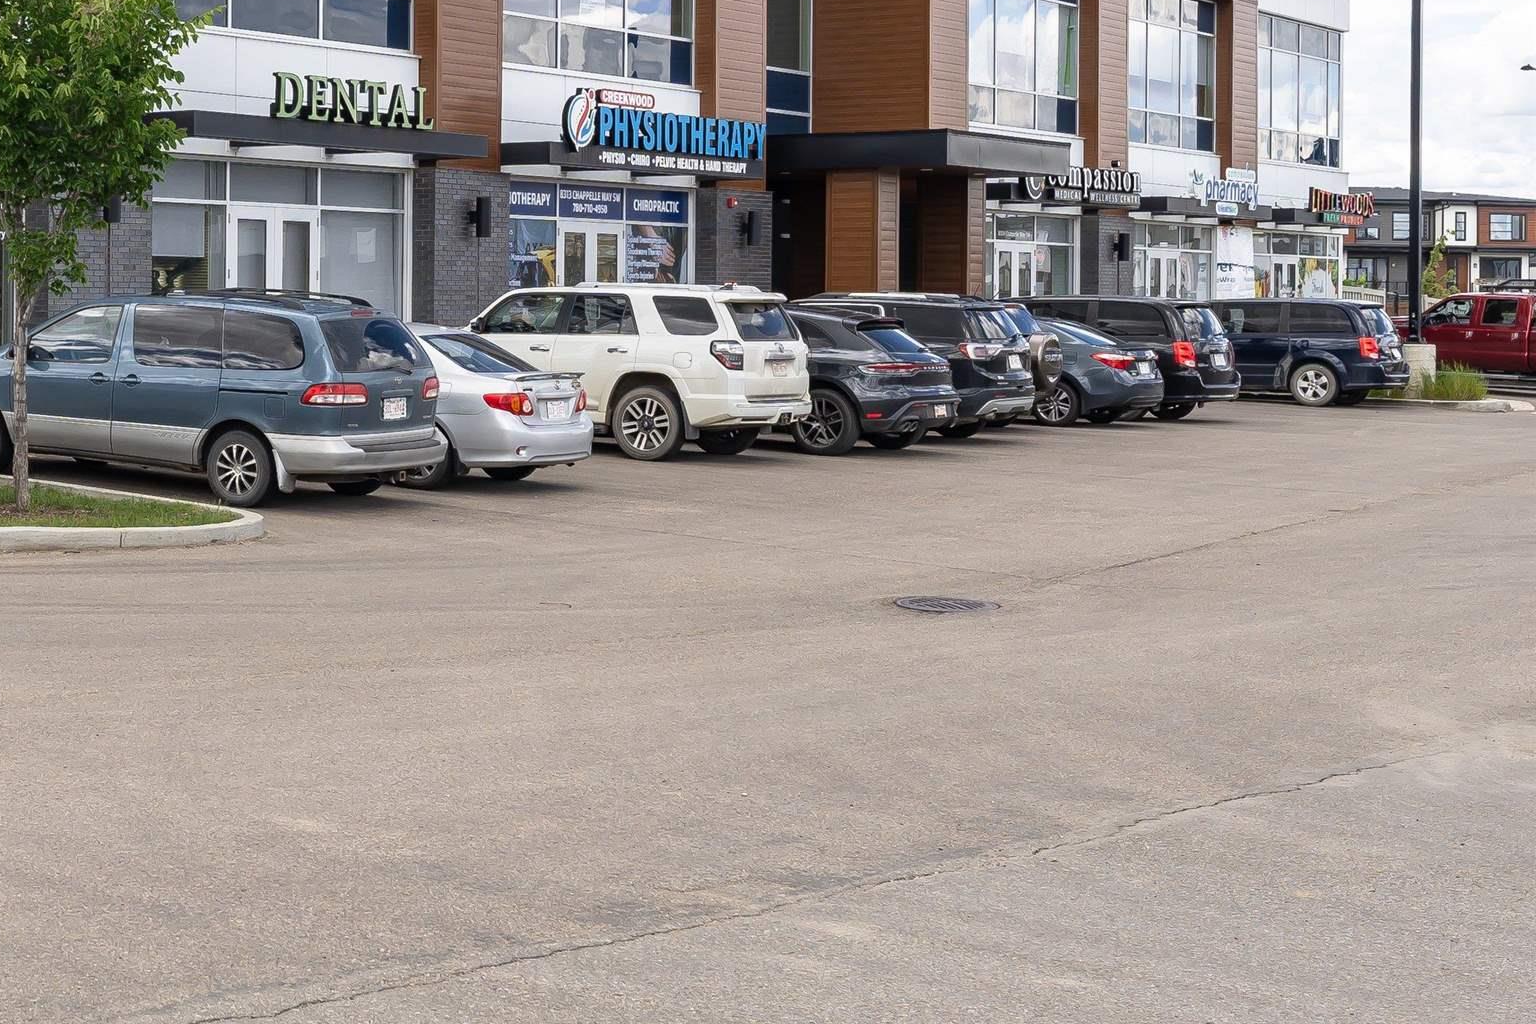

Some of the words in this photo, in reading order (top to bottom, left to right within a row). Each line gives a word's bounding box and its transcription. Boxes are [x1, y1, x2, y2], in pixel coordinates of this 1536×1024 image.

[273, 71, 434, 130] DENTAL
[600, 89, 653, 108] CREEKWOOD
[599, 106, 767, 161] PHYSIOTHERAPY
[630, 153, 650, 167] CHIRO
[655, 156, 676, 169] PELVIC
[677, 157, 699, 170] HEALTH
[722, 161, 747, 174] THERAPY
[572, 190, 601, 201] CHAPPELLE
[1206, 176, 1258, 209] pharmacy
[633, 199, 680, 213] CHIROPRACTIC
